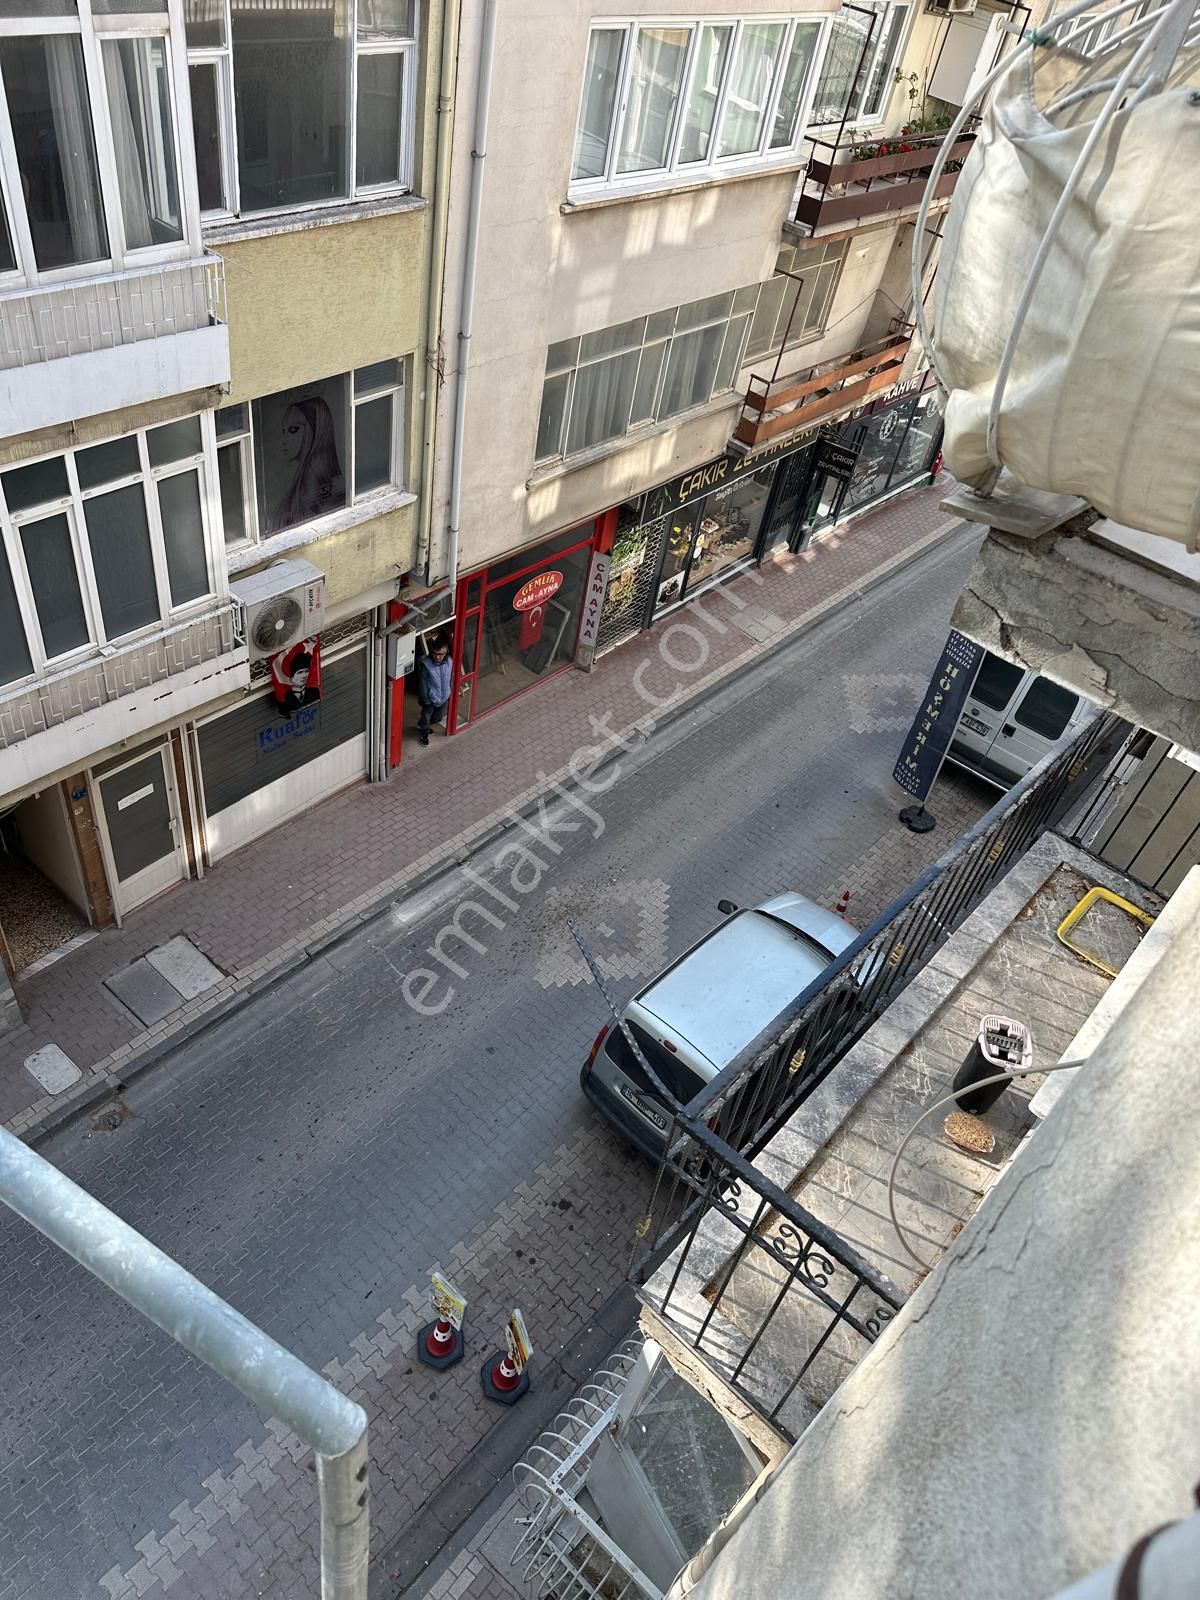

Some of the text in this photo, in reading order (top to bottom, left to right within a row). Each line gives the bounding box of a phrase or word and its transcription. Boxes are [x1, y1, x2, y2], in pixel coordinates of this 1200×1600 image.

[883, 376, 920, 402] KAHVE
[679, 459, 729, 503] ÇAKIR
[521, 572, 556, 597] GEMLİK
[584, 563, 605, 639] CAM AYNA
[259, 707, 319, 748] Kuaför
